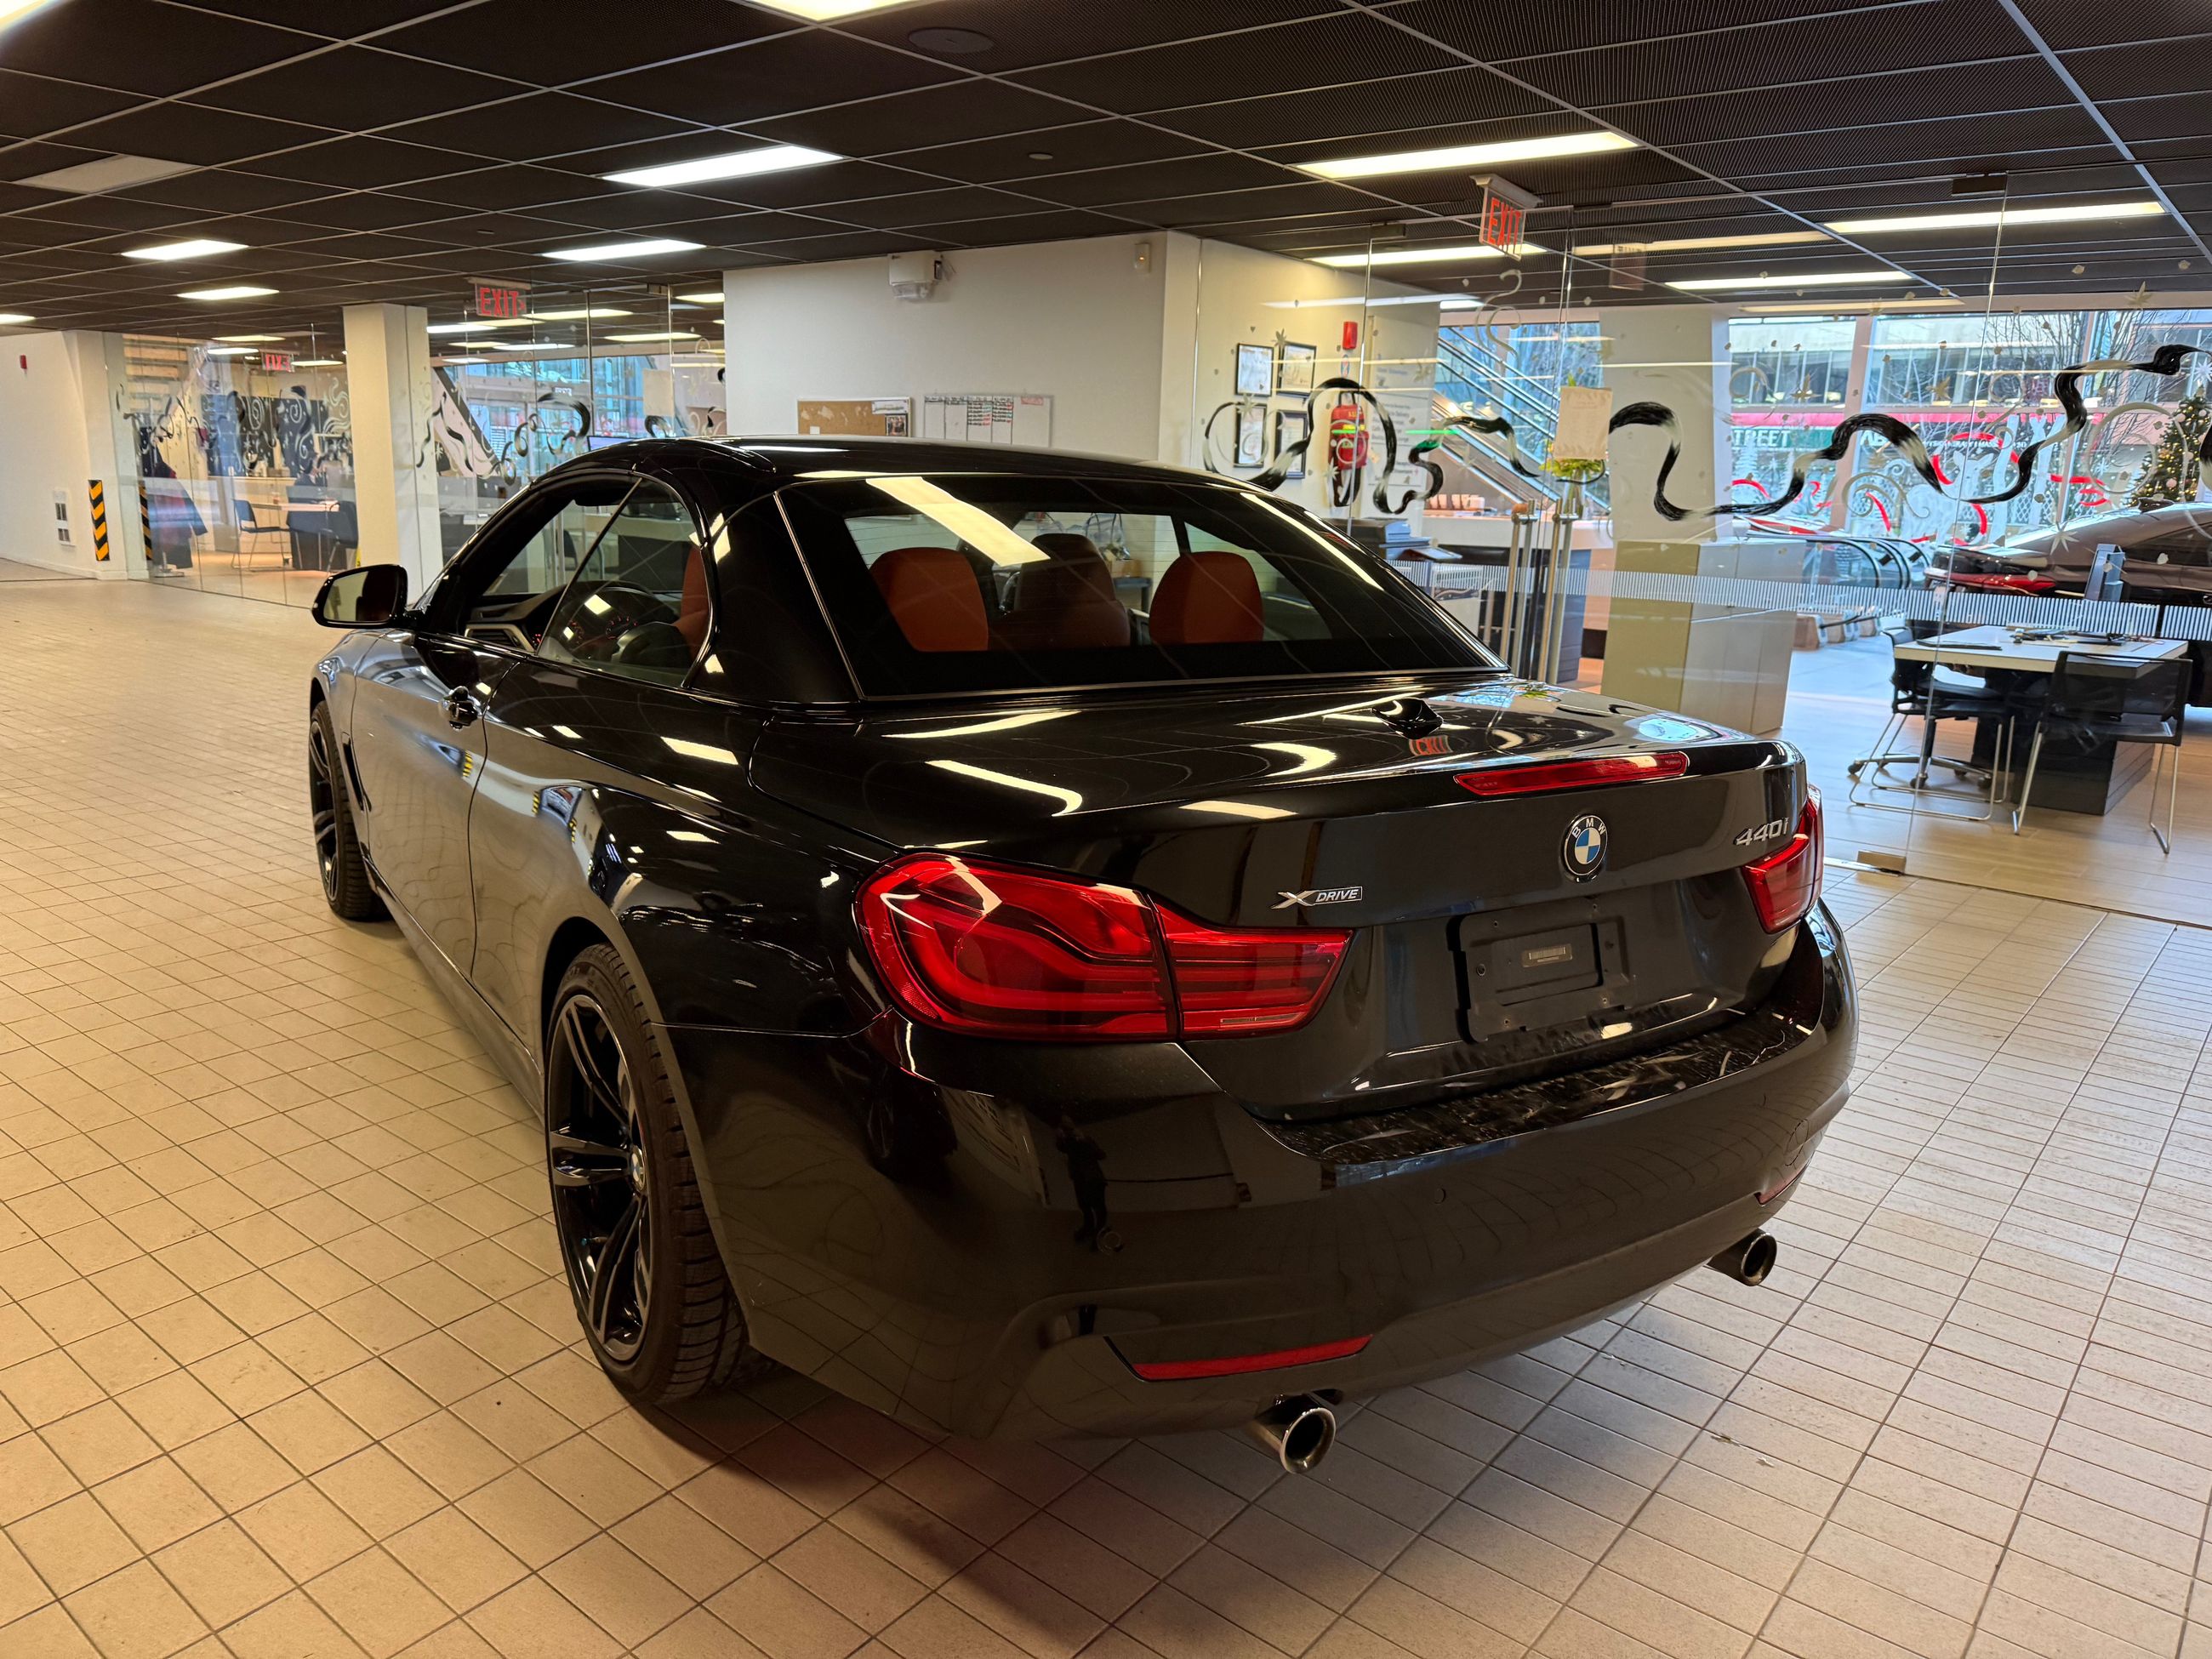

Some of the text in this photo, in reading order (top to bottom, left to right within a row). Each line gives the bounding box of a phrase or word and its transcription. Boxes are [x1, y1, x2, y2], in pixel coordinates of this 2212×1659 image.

[1487, 197, 1522, 254] EXIT
[480, 287, 518, 318] EXIT
[1571, 818, 1606, 839] BMW
[1735, 817, 1789, 846] 440i
